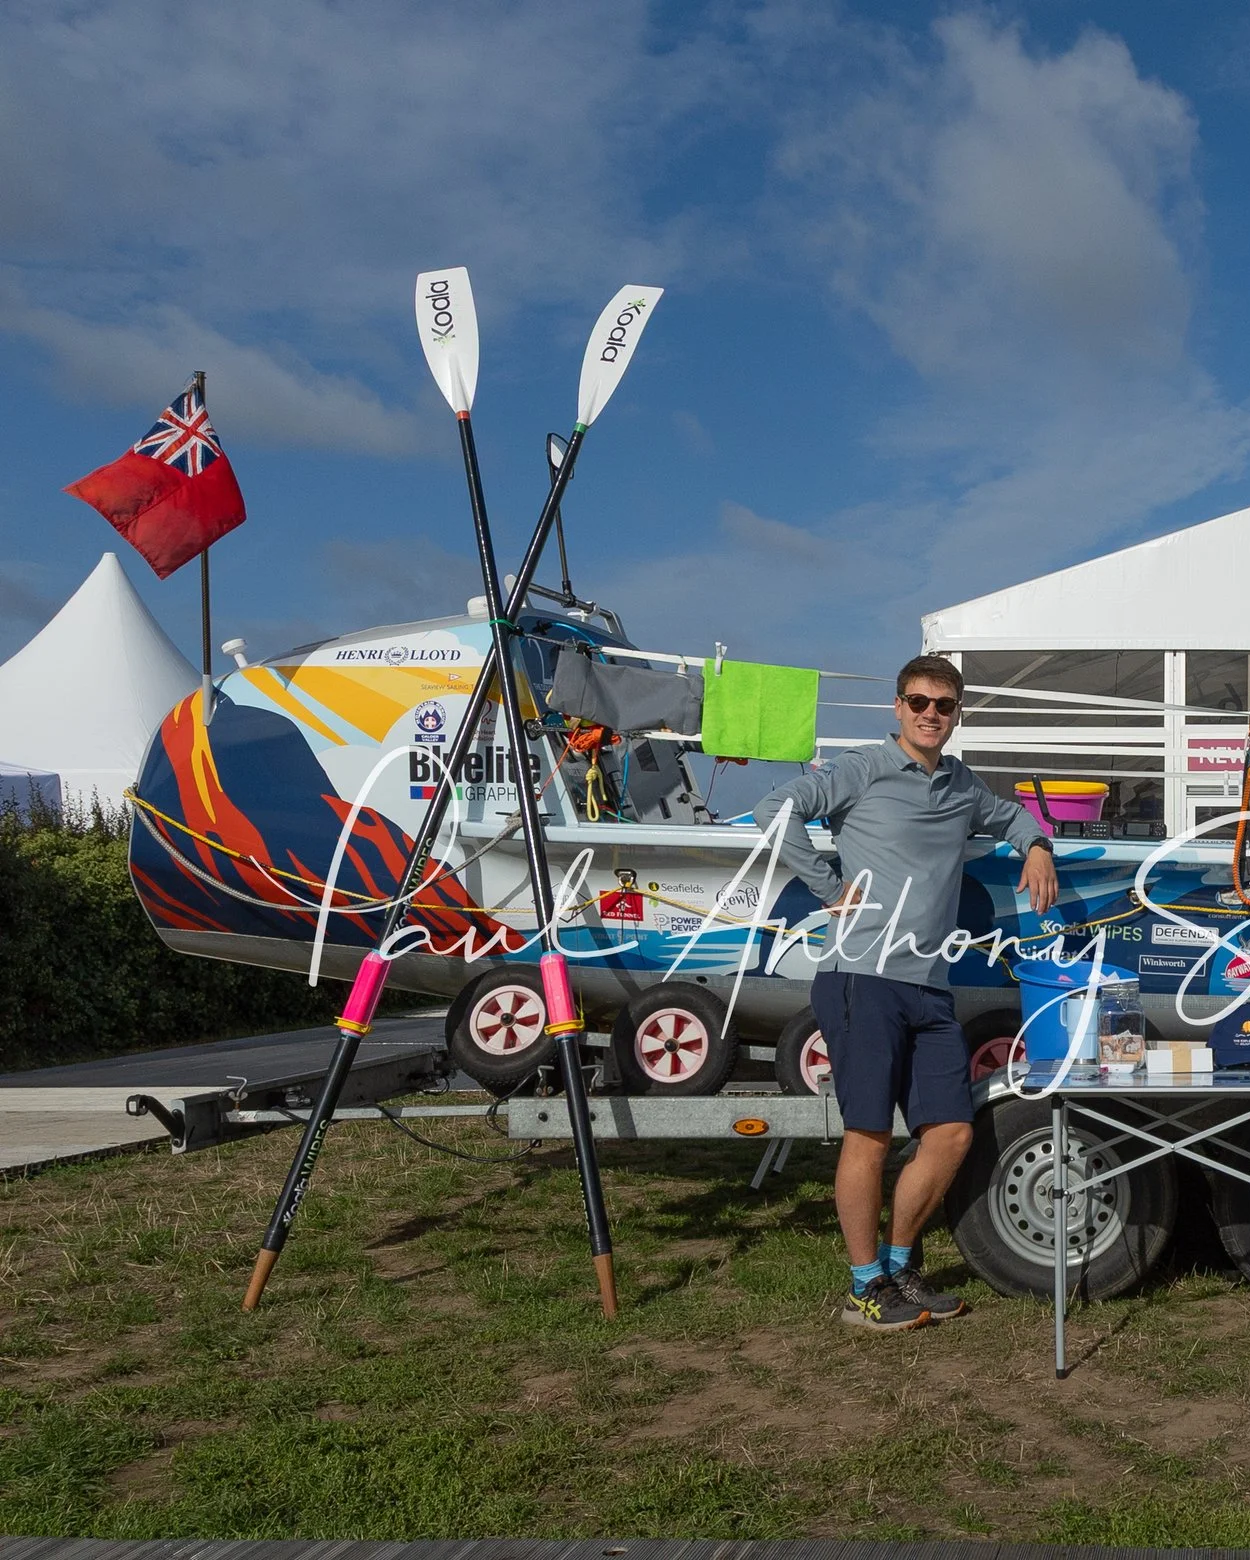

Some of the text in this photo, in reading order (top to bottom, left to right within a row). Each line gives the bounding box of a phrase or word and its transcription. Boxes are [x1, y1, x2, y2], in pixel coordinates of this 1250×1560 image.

[336, 649, 461, 661] HENRI LLOYD
[1200, 747, 1246, 764] NEW
[465, 787, 540, 801] GRAPHS
[661, 883, 704, 894] Seafields
[671, 917, 702, 925] POWER
[1155, 927, 1215, 940] DEFENDA
[1142, 958, 1186, 968] Winkworth
